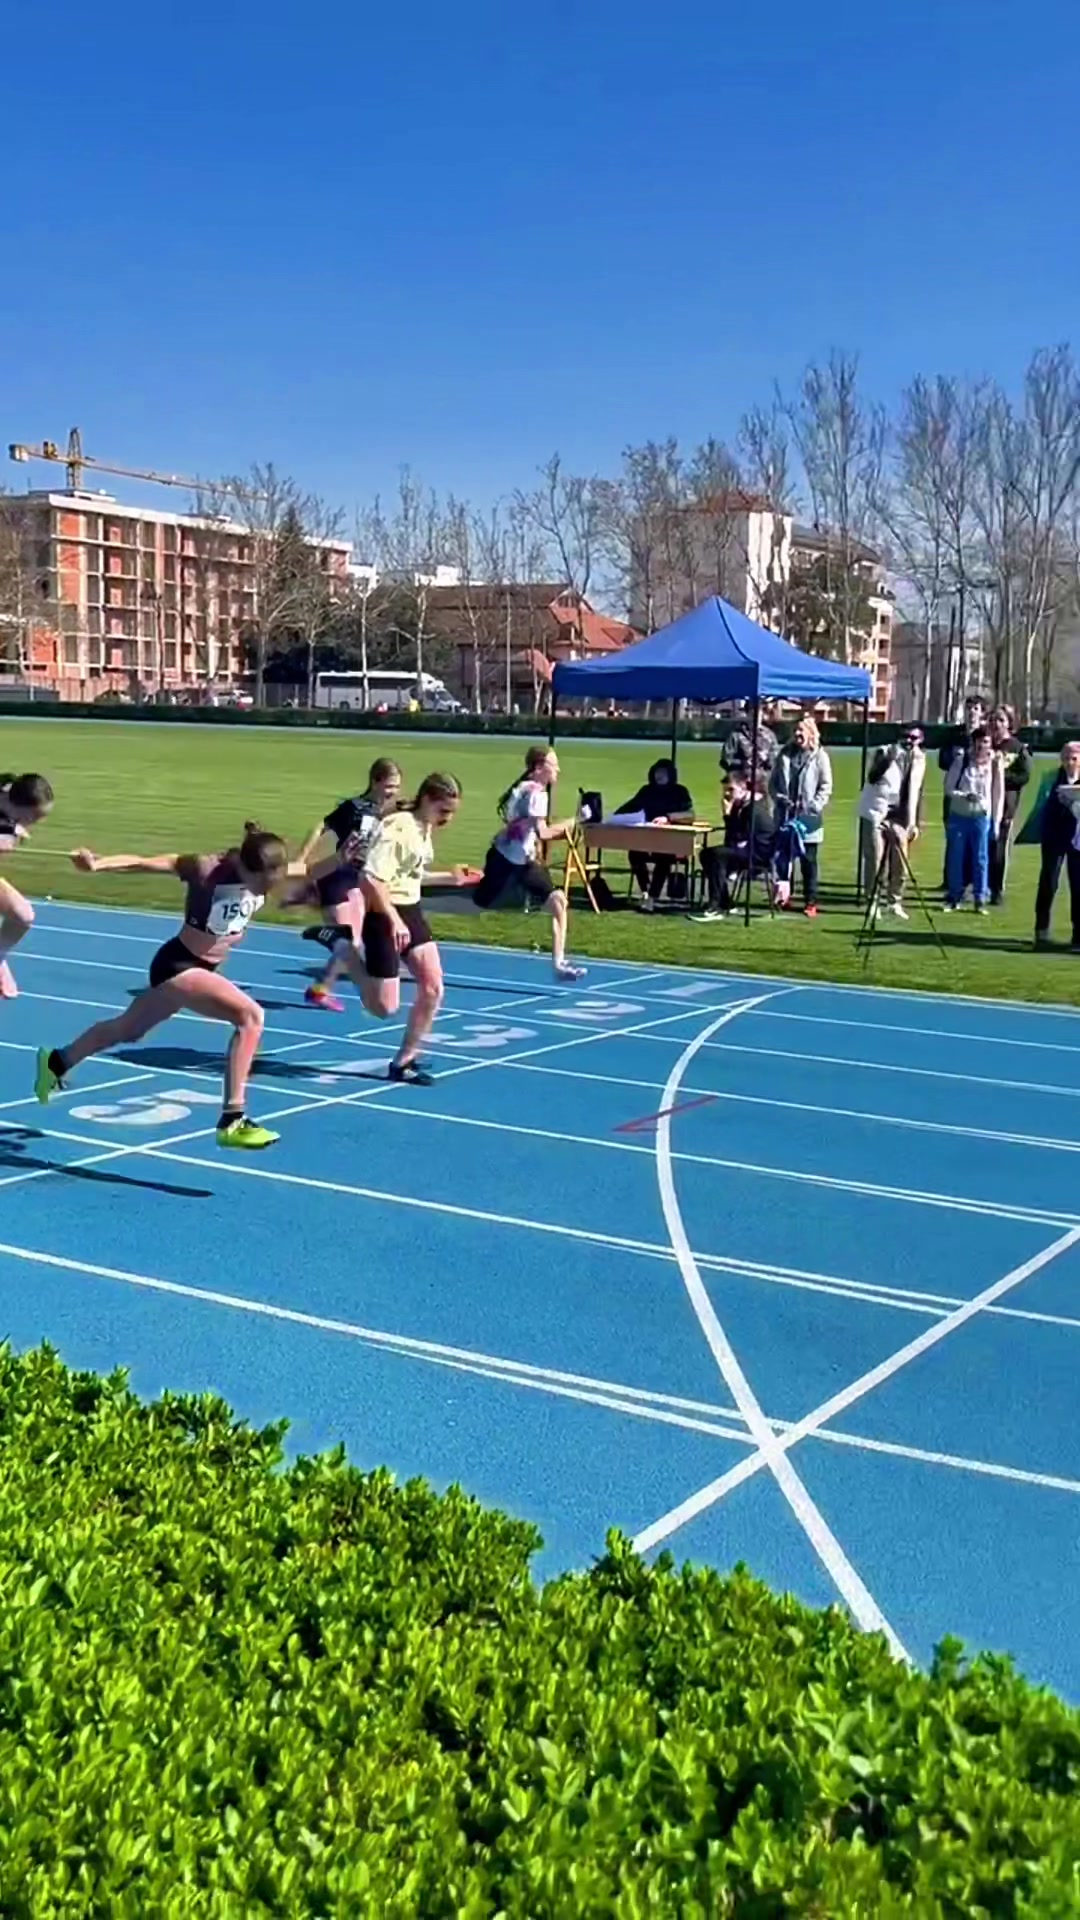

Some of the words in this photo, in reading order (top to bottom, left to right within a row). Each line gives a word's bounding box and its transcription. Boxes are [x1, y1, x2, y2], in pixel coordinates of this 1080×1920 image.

[534, 1001, 646, 1020] 2
[416, 1023, 539, 1048] 3
[69, 1089, 224, 1125] 5
